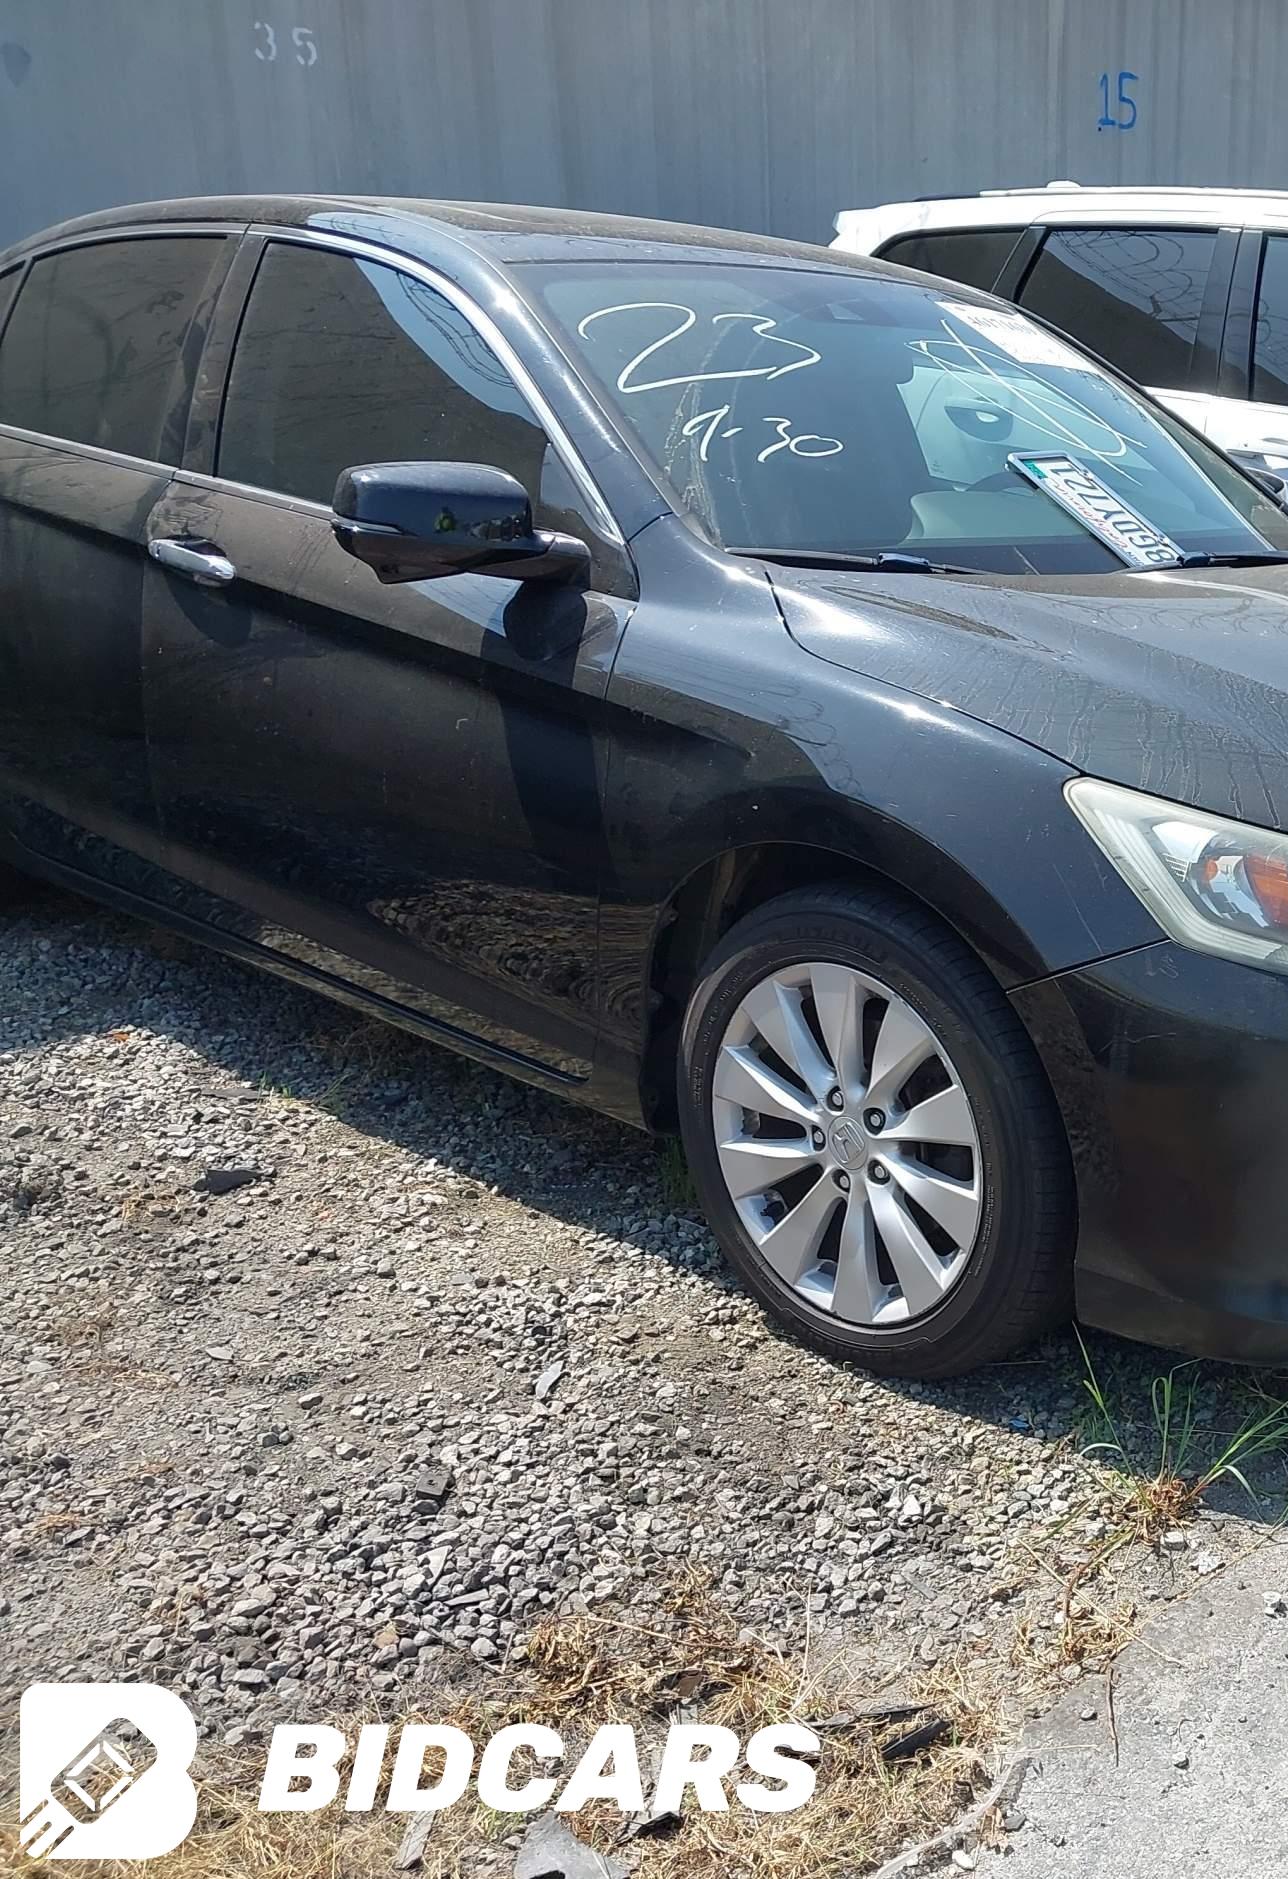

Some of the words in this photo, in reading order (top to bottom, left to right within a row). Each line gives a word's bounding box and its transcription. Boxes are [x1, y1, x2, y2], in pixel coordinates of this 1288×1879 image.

[253, 21, 318, 66] 35
[1098, 71, 1139, 129] 15
[577, 302, 822, 394] 23
[1049, 463, 1176, 563] 8GDY721
